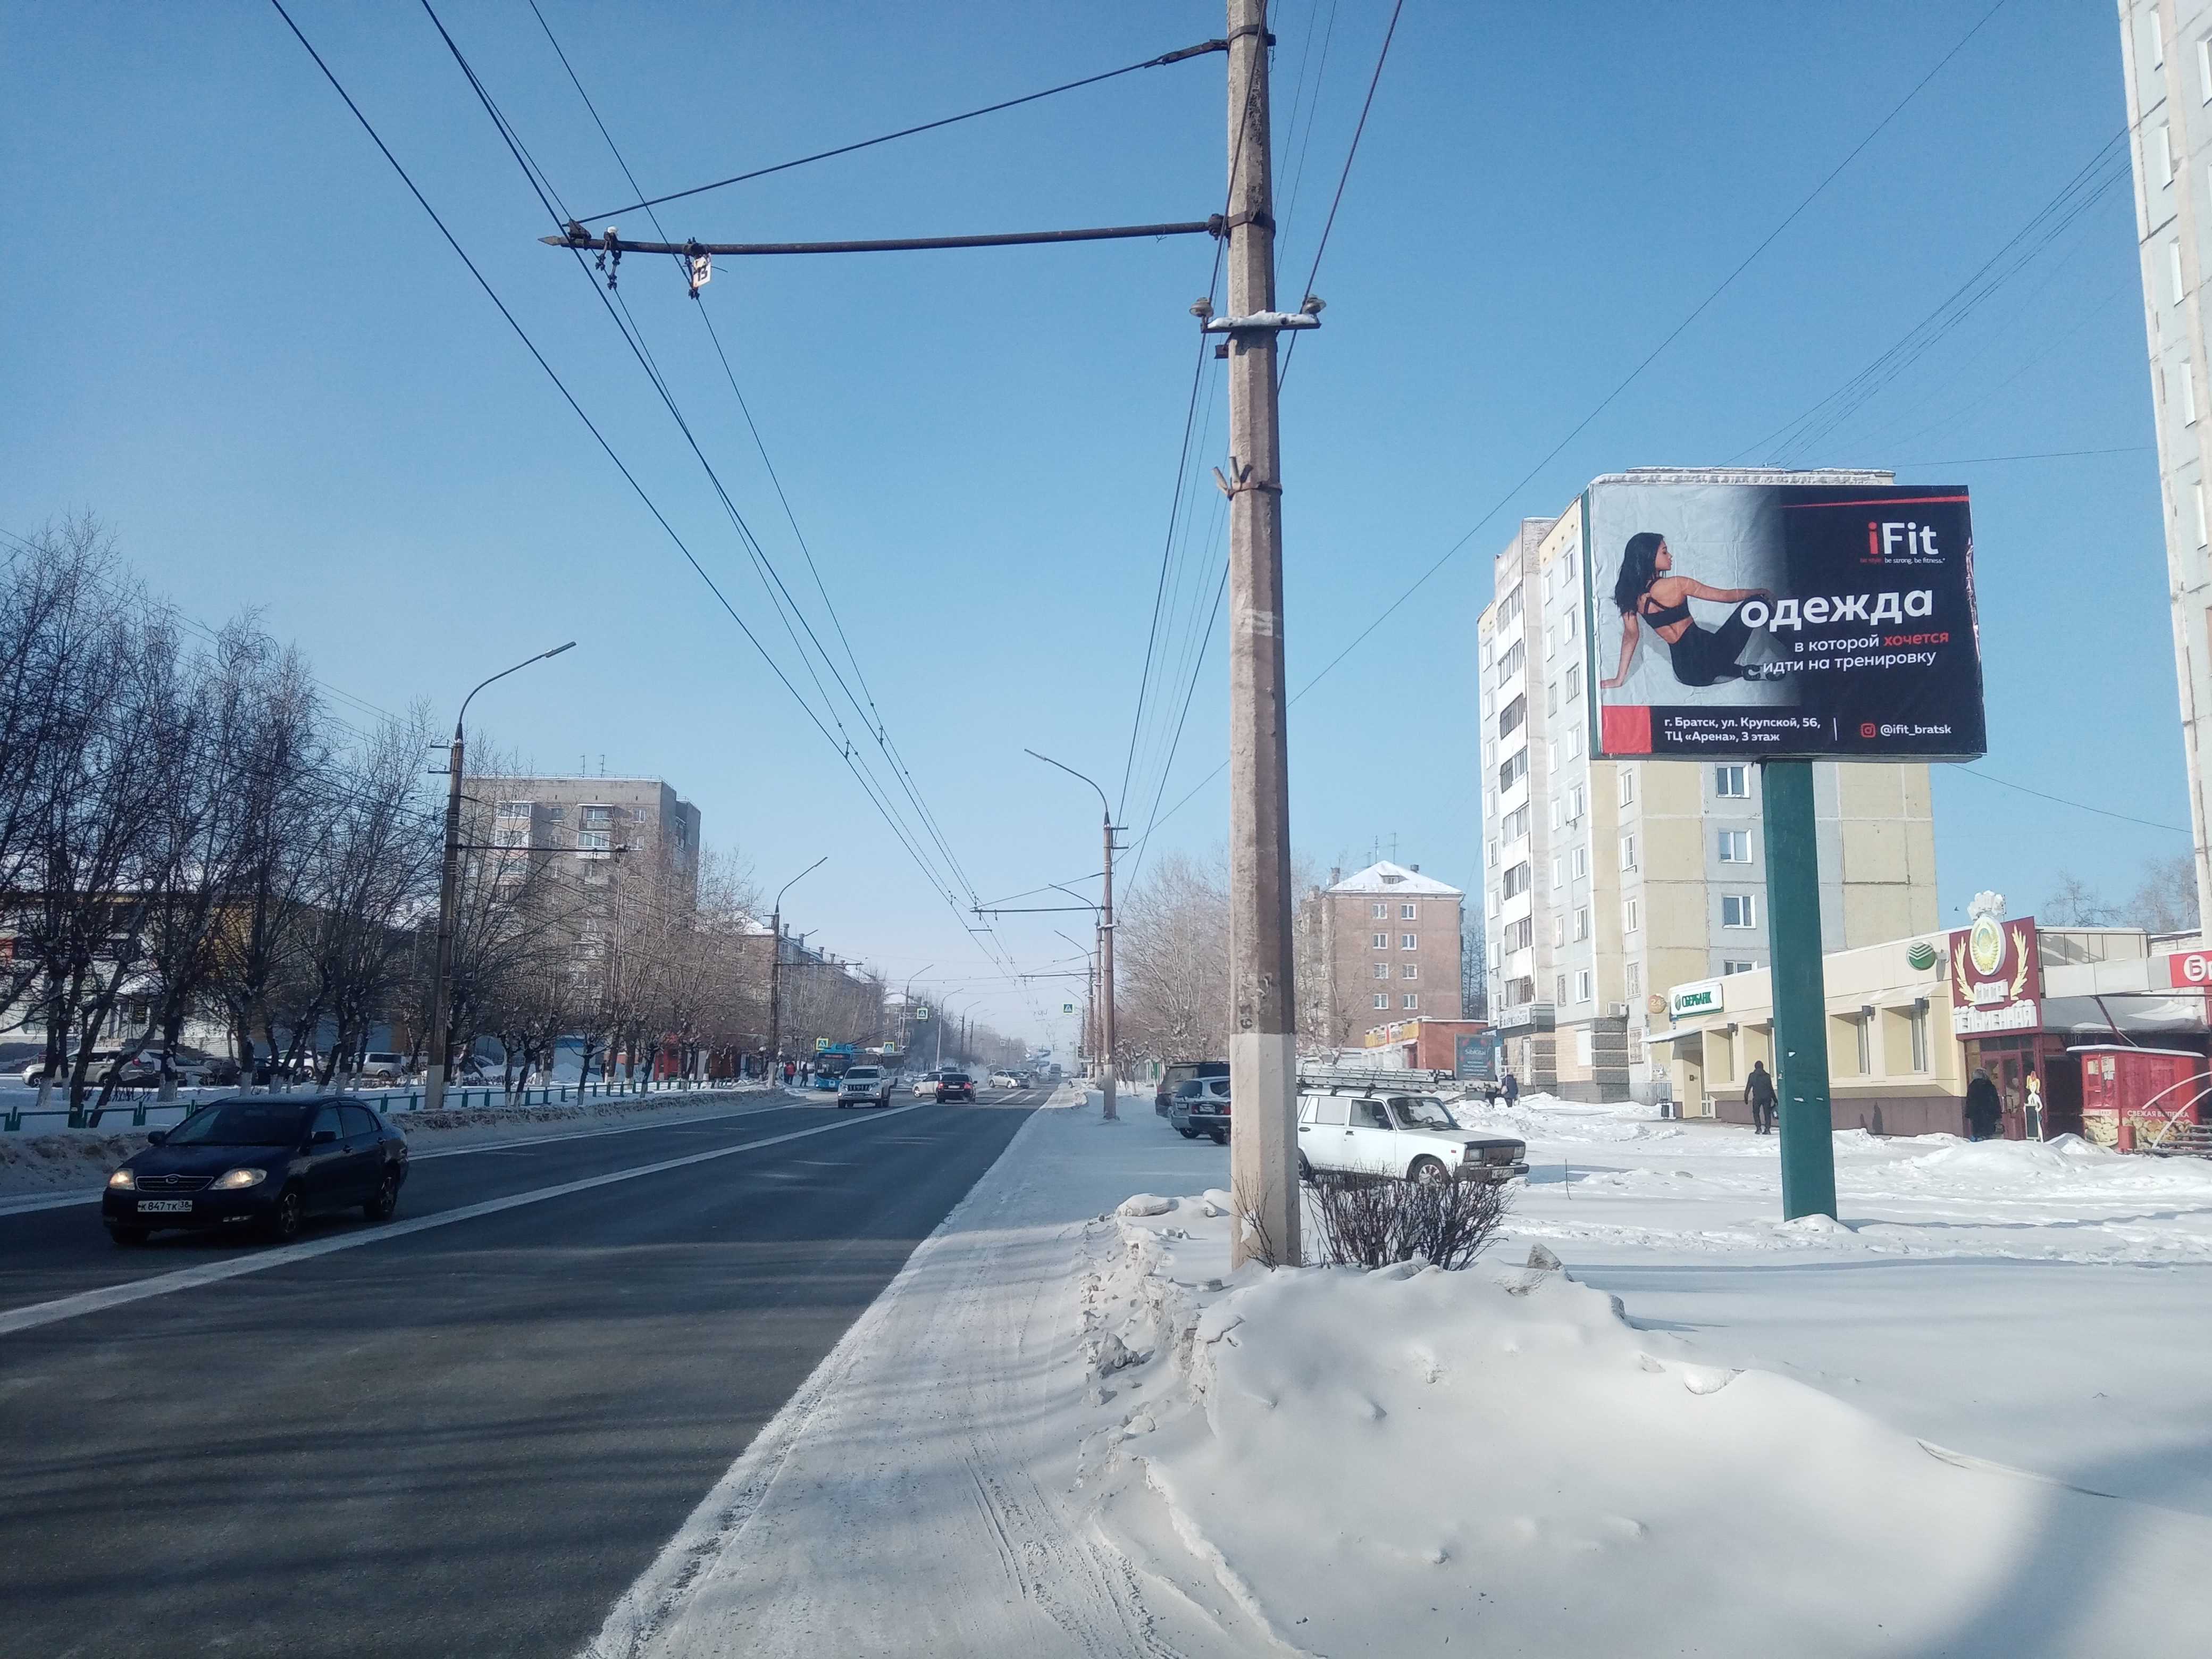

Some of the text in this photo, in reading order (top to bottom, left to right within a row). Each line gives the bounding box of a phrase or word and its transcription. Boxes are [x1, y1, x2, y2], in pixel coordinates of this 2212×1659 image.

[1868, 521, 1939, 555] iFit
[1740, 589, 1933, 633] одежда
[1794, 632, 1949, 653] в которой хочется
[1762, 651, 1937, 675] идти на тренировку
[1664, 717, 1821, 730] г. Братск, ул. Крупской, 56,
[1880, 724, 1953, 737] @ifit_bratsk
[1664, 731, 1683, 742] ТЦ
[1685, 731, 1739, 743] «Арена»,
[1741, 732, 1749, 741] 3
[1681, 991, 1713, 1008] СБЕРБАНК
[1953, 1002, 2038, 1034] ПЕЛЬМЕННАЯ
[2127, 1109, 2156, 1118] СВЕЖАЯ
